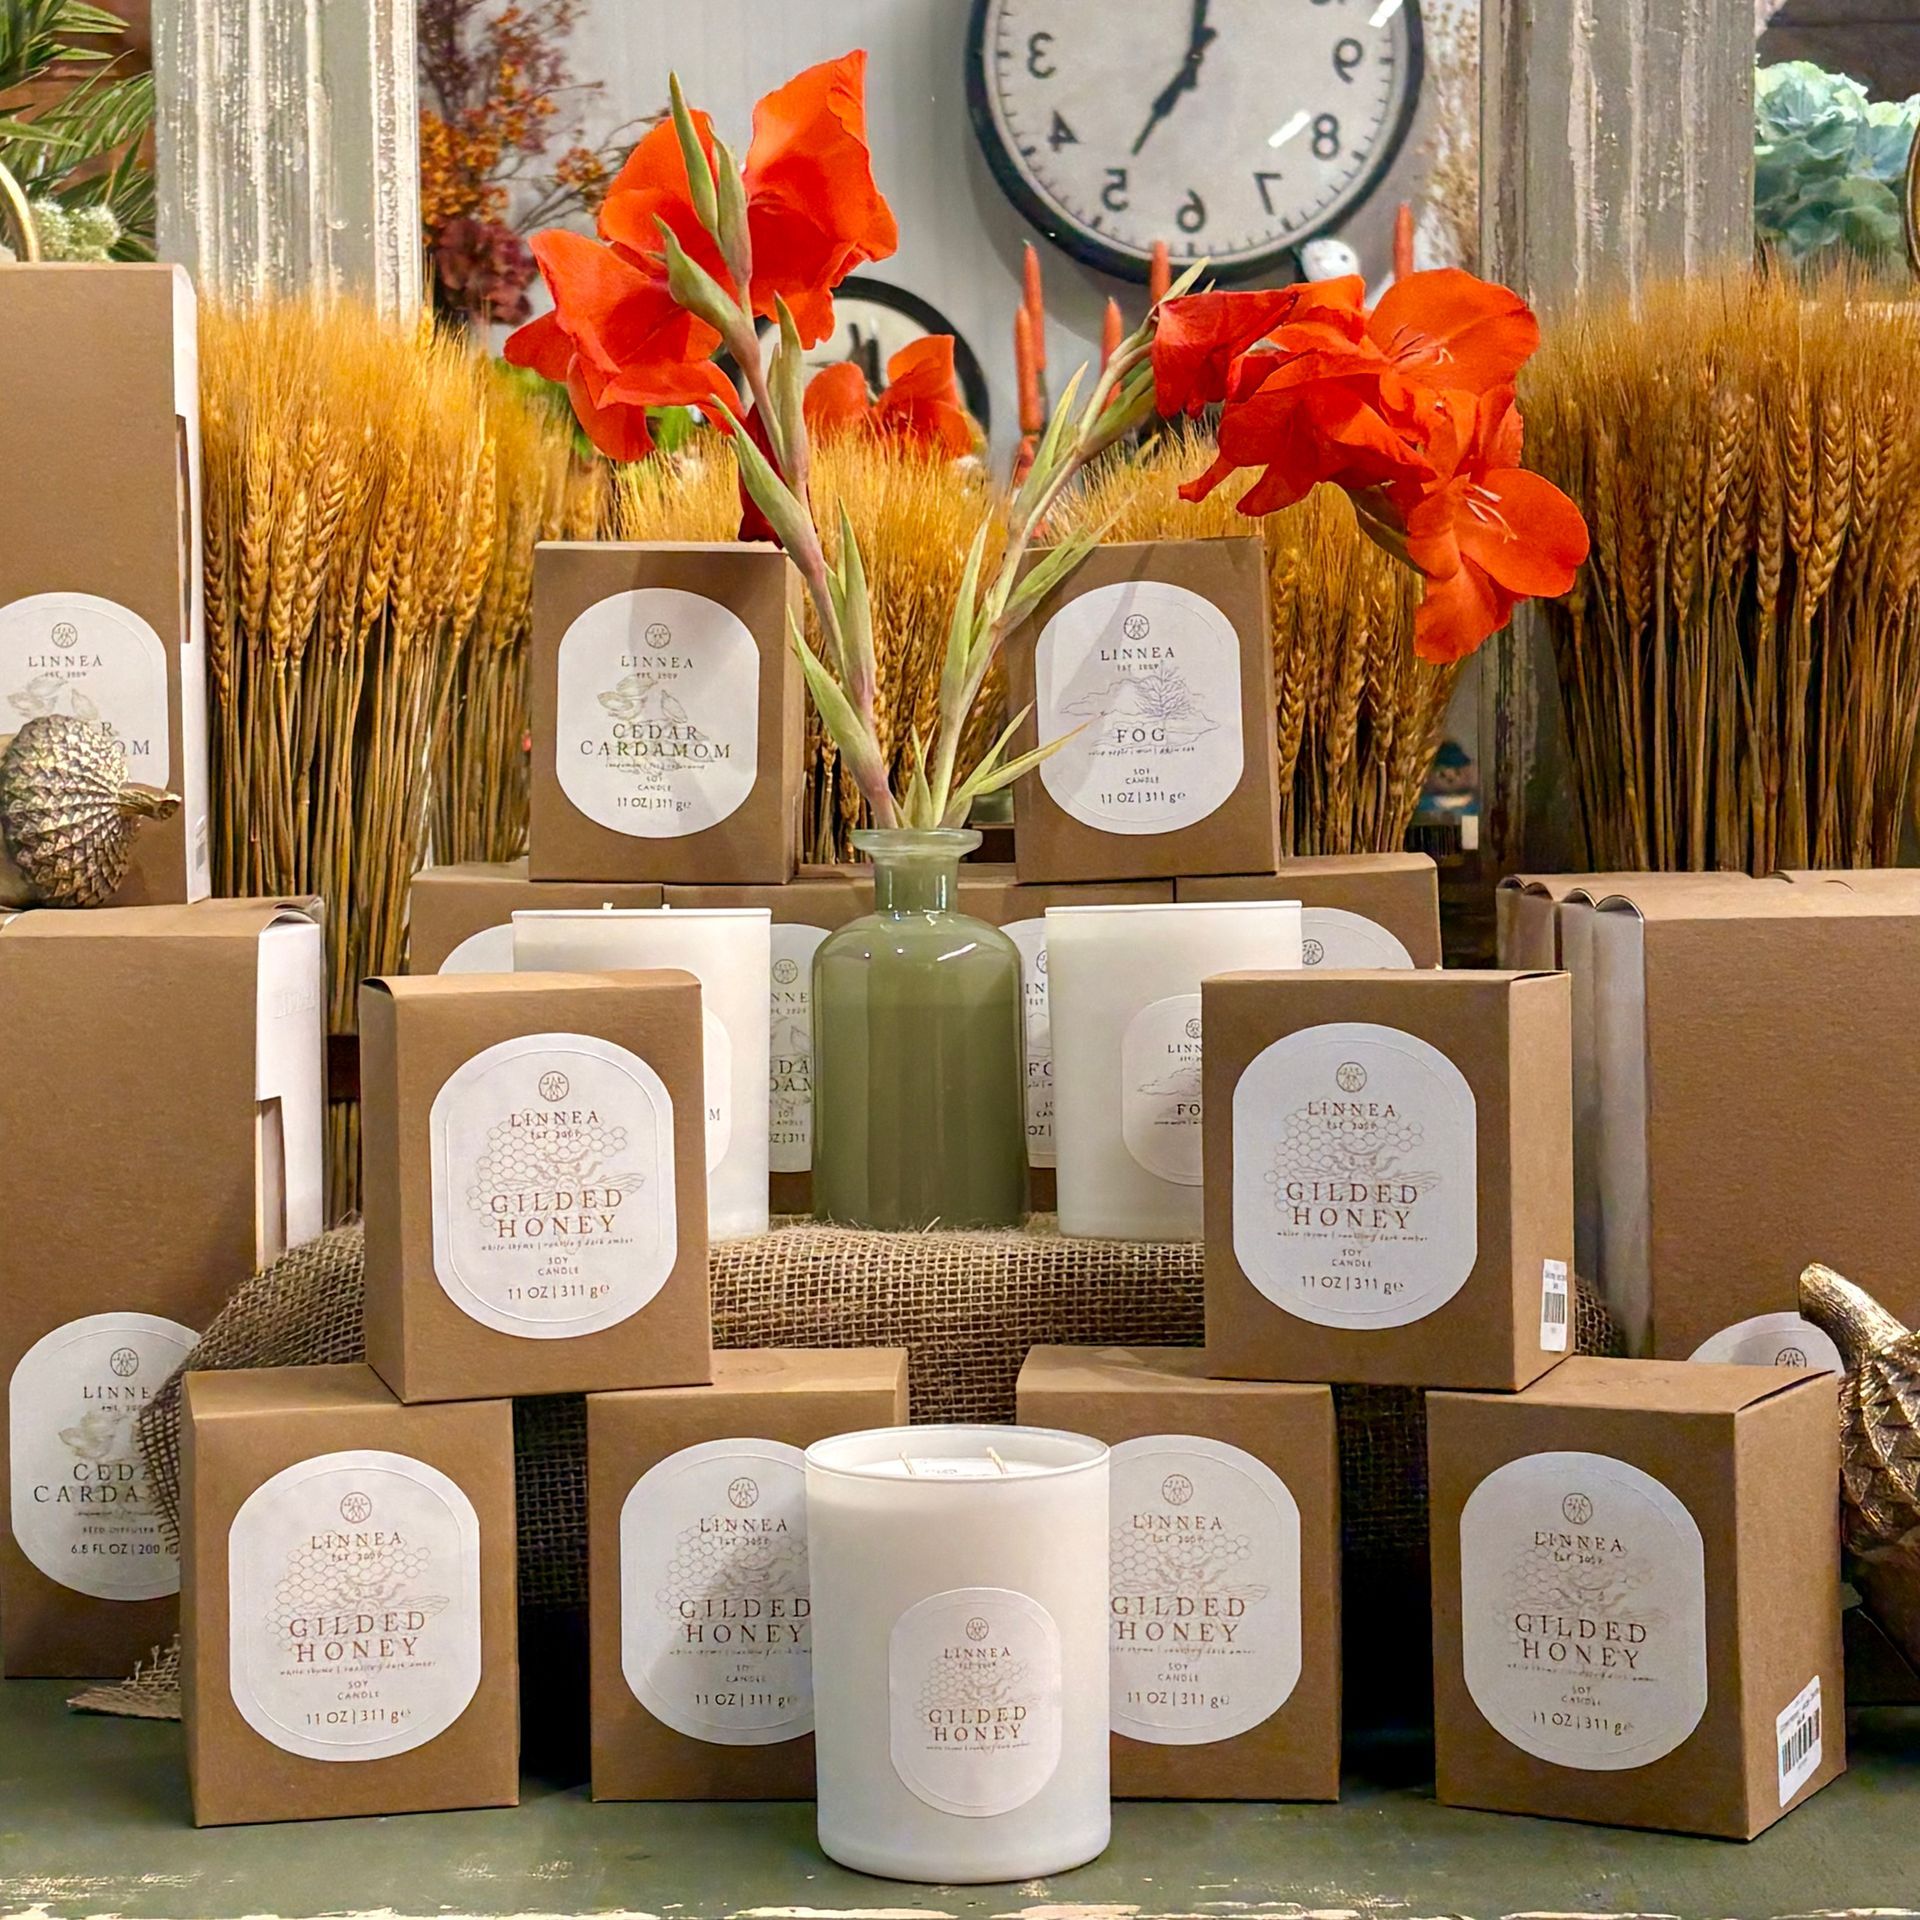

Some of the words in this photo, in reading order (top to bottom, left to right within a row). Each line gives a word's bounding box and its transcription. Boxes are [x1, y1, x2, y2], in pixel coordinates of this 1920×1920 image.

[28, 654, 103, 669] LINNEA
[620, 655, 694, 669] LINNEA
[1100, 646, 1176, 661] LINNEA
[612, 723, 699, 741] CEDAR
[1116, 727, 1166, 744] FOG
[580, 740, 732, 759] CARDAMOM
[631, 797, 648, 809] OZ
[1116, 792, 1134, 803] OZ
[1167, 1043, 1203, 1054] LINN
[1028, 1062, 1053, 1077] FO
[1177, 1103, 1202, 1116] FO
[1307, 1101, 1397, 1118] LINNEA
[510, 1110, 600, 1128] LINNEA
[490, 1188, 623, 1214] GILDED
[1286, 1182, 1418, 1205] GILDED
[498, 1214, 616, 1238] HONEY
[1293, 1207, 1411, 1231] HONEY
[1301, 1275, 1315, 1288] 11
[1321, 1276, 1342, 1290] OZ
[1354, 1277, 1378, 1290] 311
[508, 1287, 522, 1300] 11
[527, 1286, 549, 1299] OZ
[561, 1285, 585, 1297] 311
[83, 1386, 151, 1399] LINNE
[73, 1463, 134, 1481] CED
[33, 1485, 138, 1503] CARDA
[699, 1517, 788, 1533] LINNEA
[1132, 1514, 1223, 1531] LINNEA
[93, 1543, 106, 1555] FL
[108, 1543, 128, 1555] OZ
[311, 1531, 403, 1550] LINNEA
[1534, 1531, 1624, 1553] LINNEA
[678, 1598, 811, 1619] GILDED
[1111, 1595, 1246, 1618] GILDED
[289, 1610, 425, 1638] GILDED
[685, 1623, 805, 1643] HONEY
[1117, 1620, 1239, 1644] HONEY
[1515, 1613, 1647, 1645] GILDED
[296, 1636, 419, 1663] HONEY
[944, 1646, 1011, 1659] LINNEA
[1522, 1638, 1640, 1670] HONEY
[1127, 1691, 1141, 1703] 11
[1146, 1691, 1167, 1704] OZ
[1181, 1692, 1205, 1705] 311
[306, 1713, 320, 1725] 11
[326, 1710, 348, 1724] OZ
[360, 1708, 385, 1722] 311
[928, 1705, 1027, 1725] GILDED
[1551, 1712, 1572, 1727] OZ
[934, 1723, 1021, 1742] HONEY
